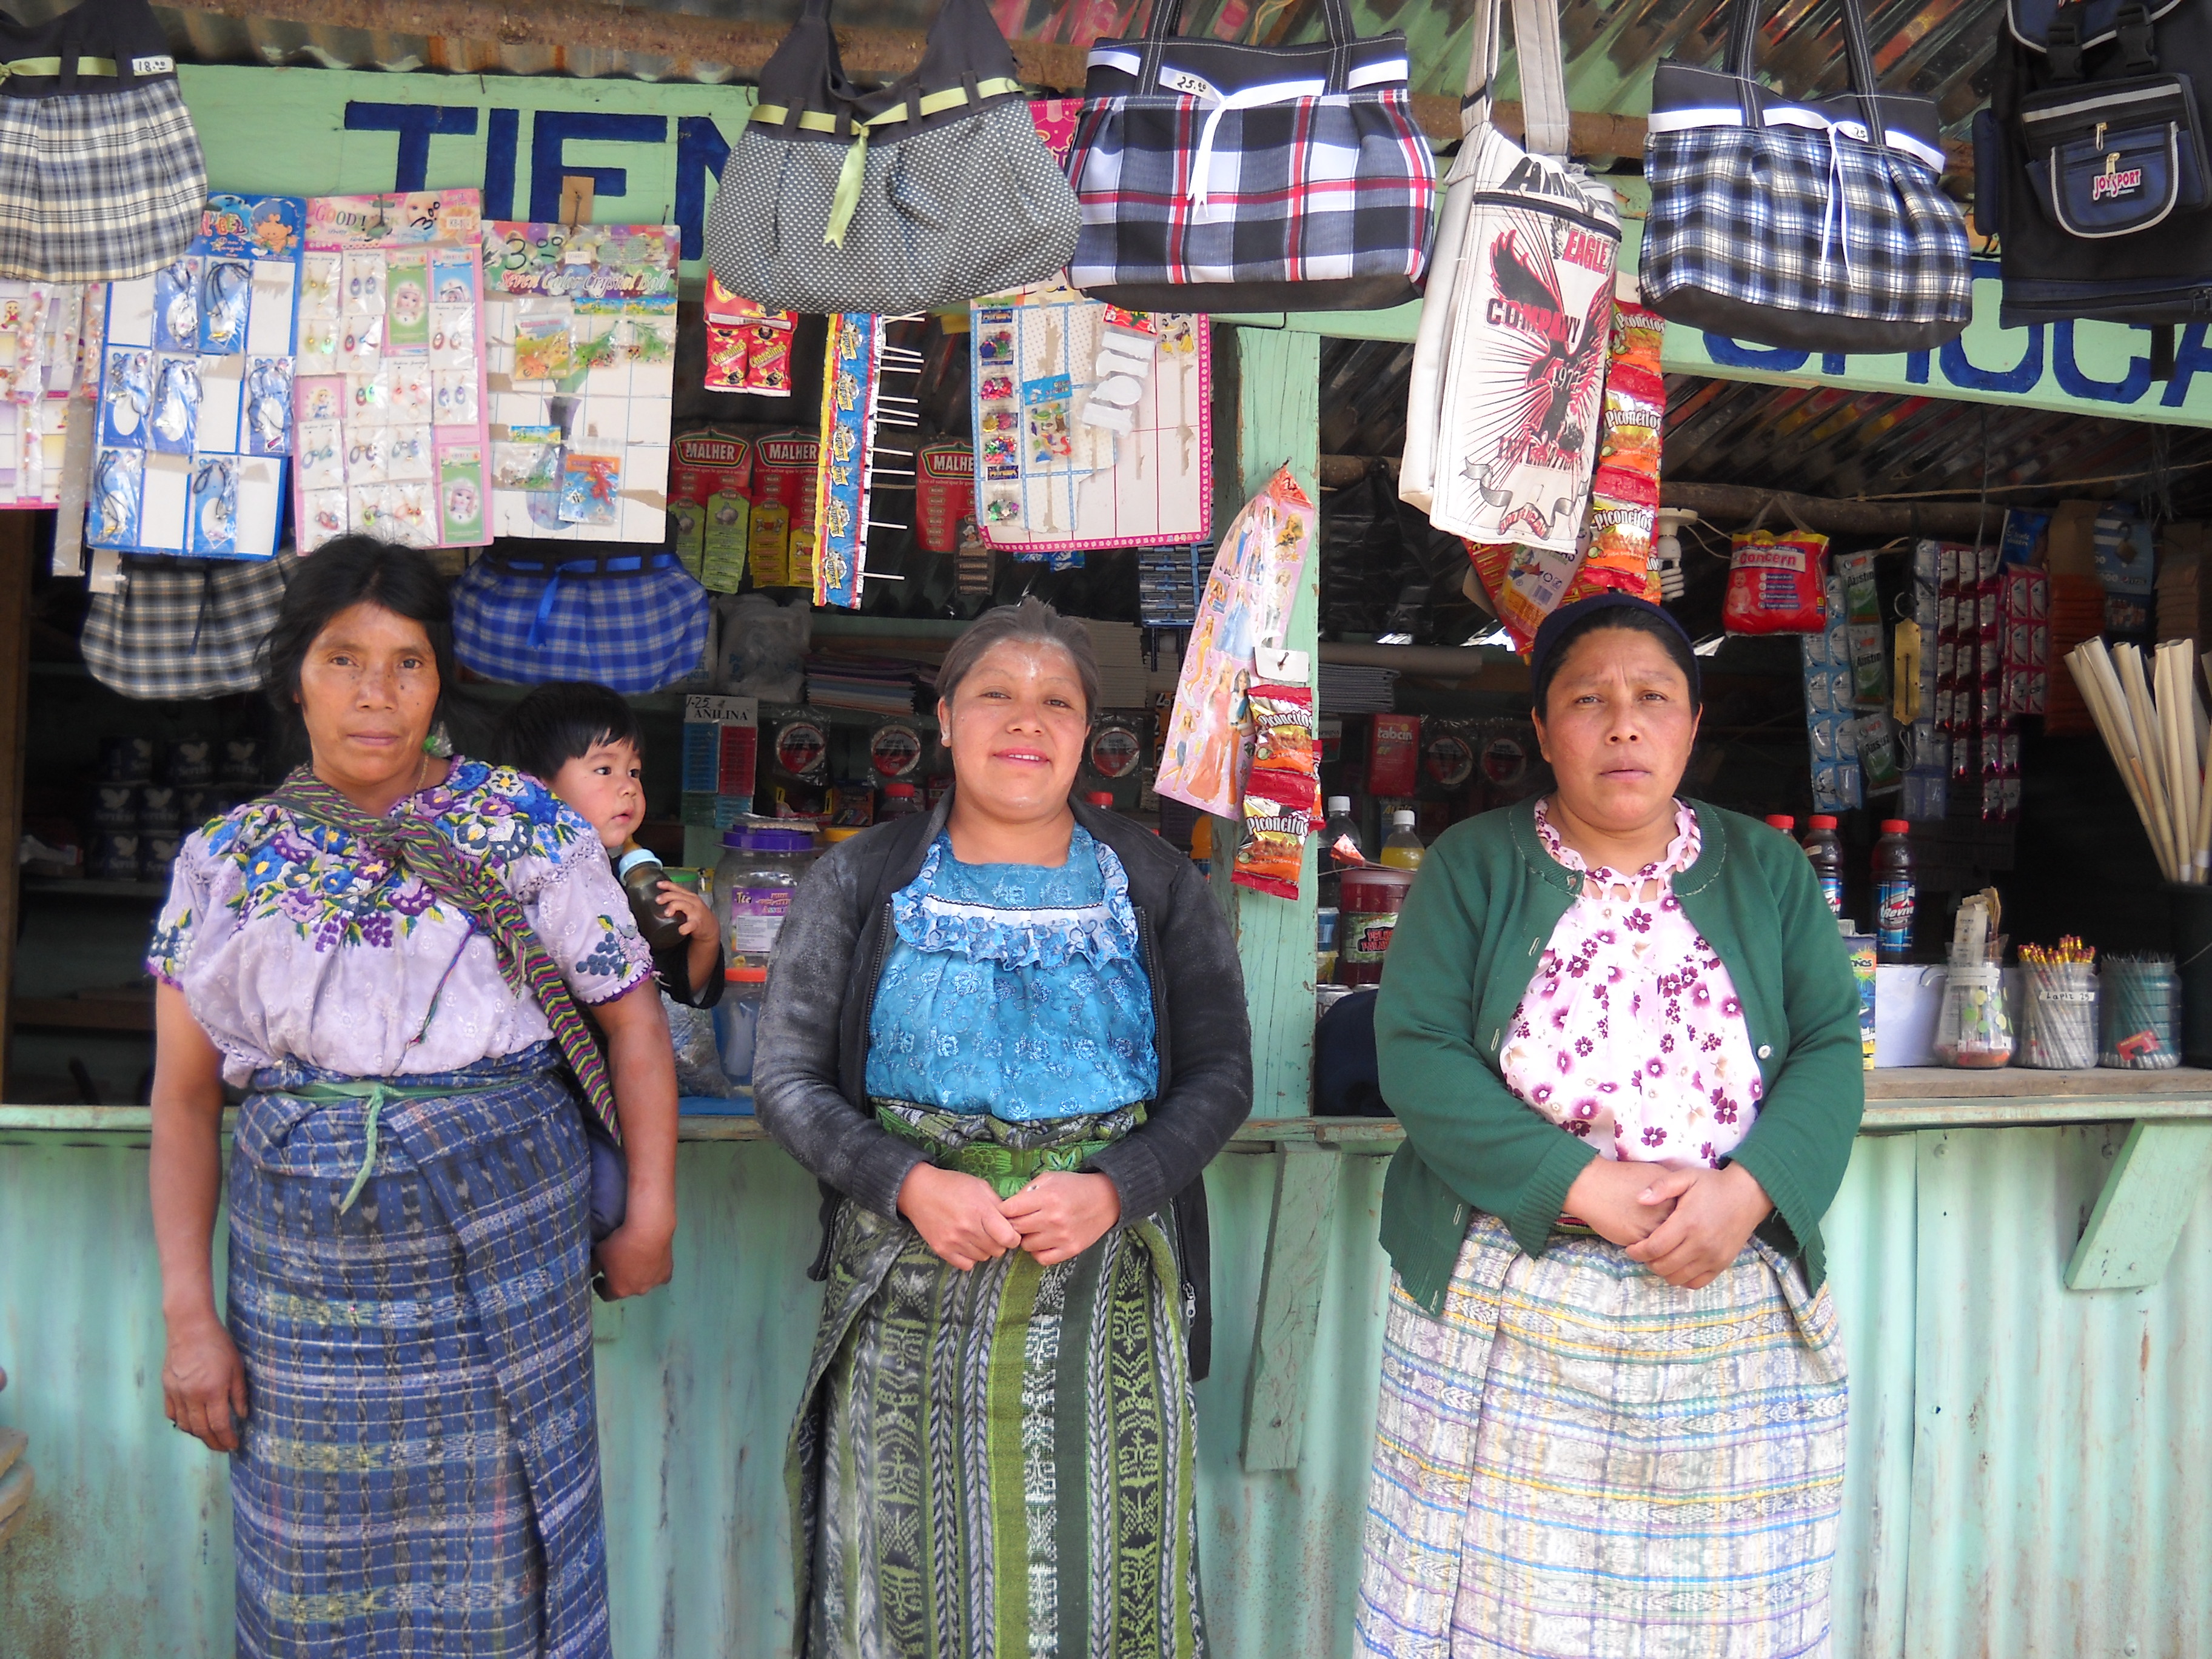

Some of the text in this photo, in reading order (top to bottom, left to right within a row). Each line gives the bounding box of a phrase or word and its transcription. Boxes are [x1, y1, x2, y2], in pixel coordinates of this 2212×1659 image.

[1562, 228, 1609, 274] EAGLE
[1486, 298, 1581, 344] COMPANY
[1606, 408, 1662, 430] Piconcitos
[686, 442, 735, 460] MALHER
[769, 443, 817, 460] MALHER
[934, 455, 974, 472] MALHE
[1594, 509, 1654, 532] Piconcitos
[1739, 552, 1797, 565] Concern
[694, 709, 748, 720] ANILINA
[1258, 710, 1313, 729] Piconcitos
[1378, 726, 1412, 740] tabcin
[1246, 814, 1310, 837] Piconcitos
